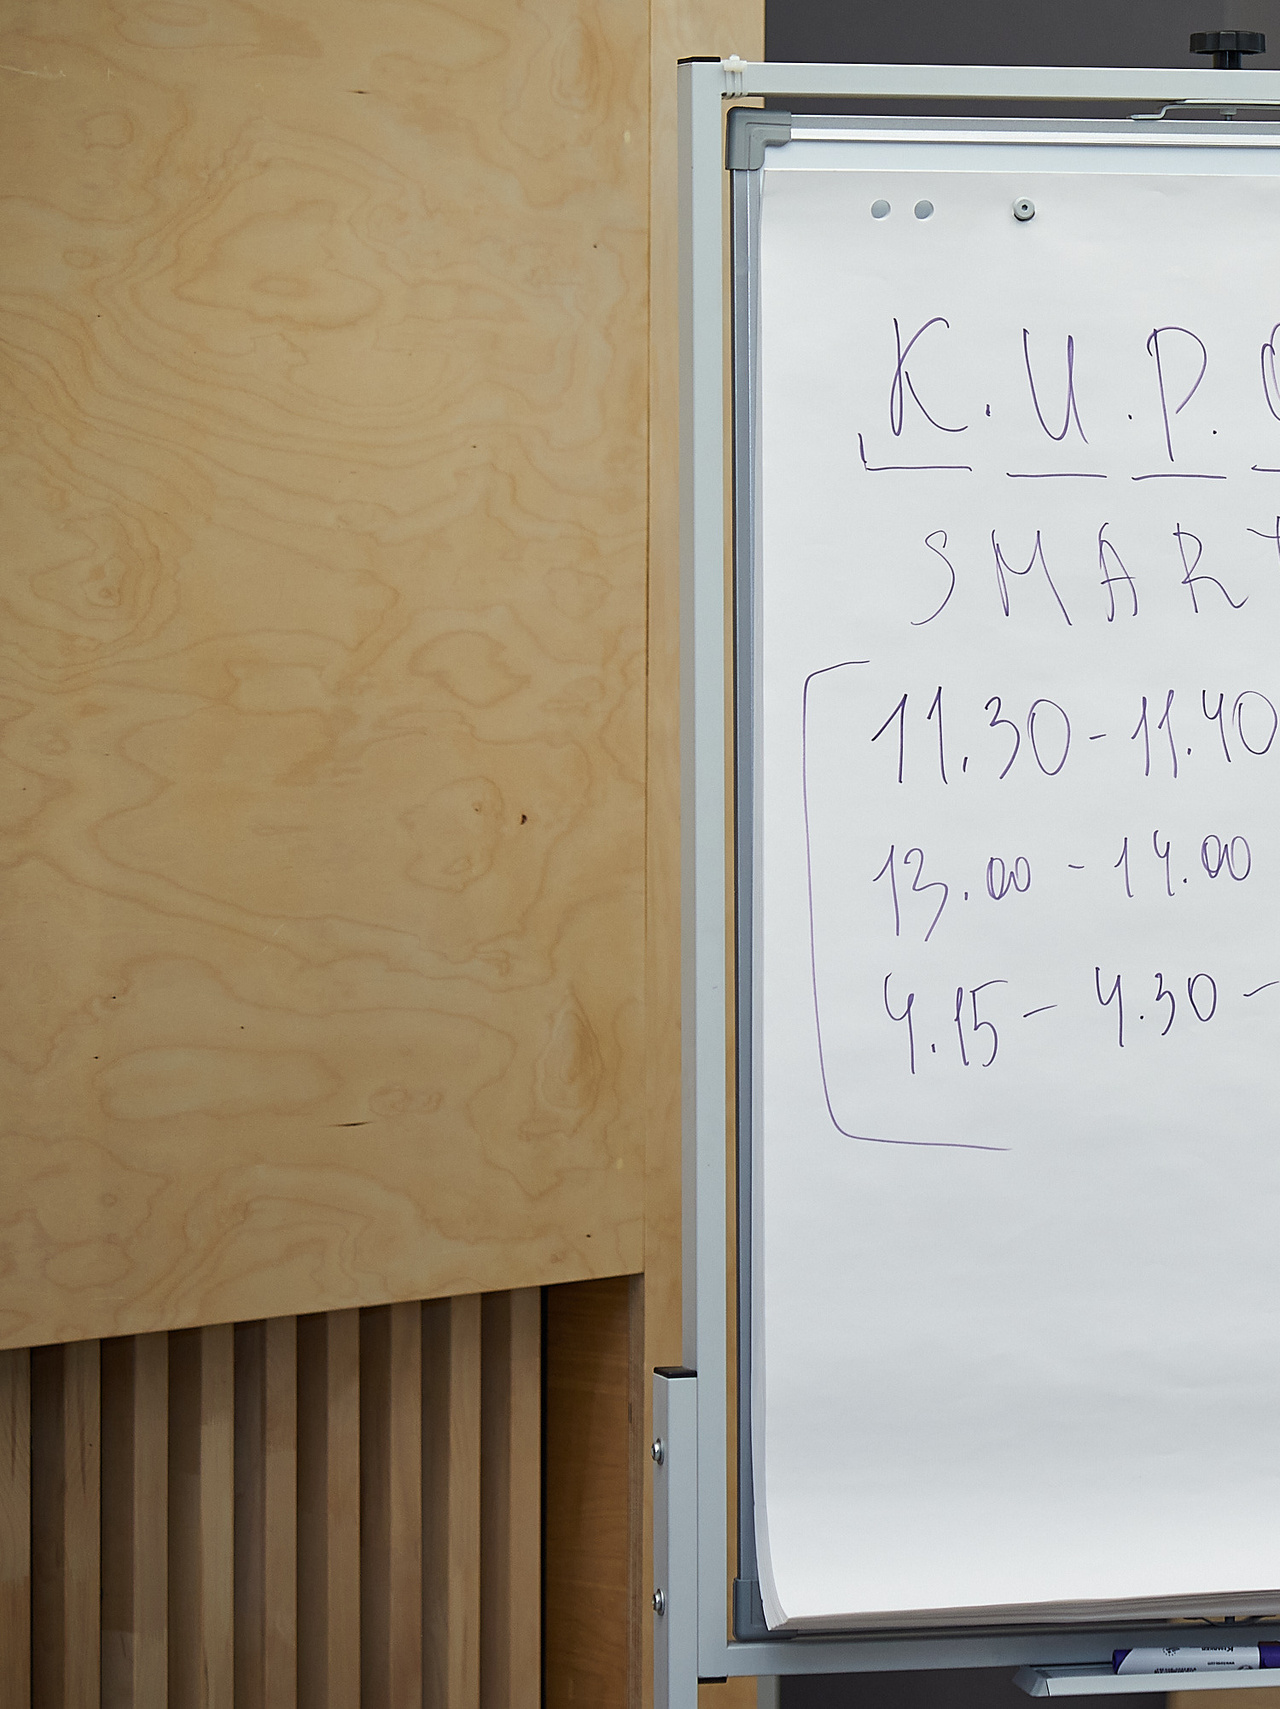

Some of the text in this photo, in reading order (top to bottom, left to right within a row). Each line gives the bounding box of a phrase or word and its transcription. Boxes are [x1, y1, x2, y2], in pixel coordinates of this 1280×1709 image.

[871, 686, 1071, 784] 11.30
[1130, 689, 1278, 778] 11.40
[872, 844, 1032, 942] 13.00
[1114, 829, 1252, 898] 14.00
[885, 971, 1009, 1075] 4.15
[1096, 966, 1218, 1047] 4.30
